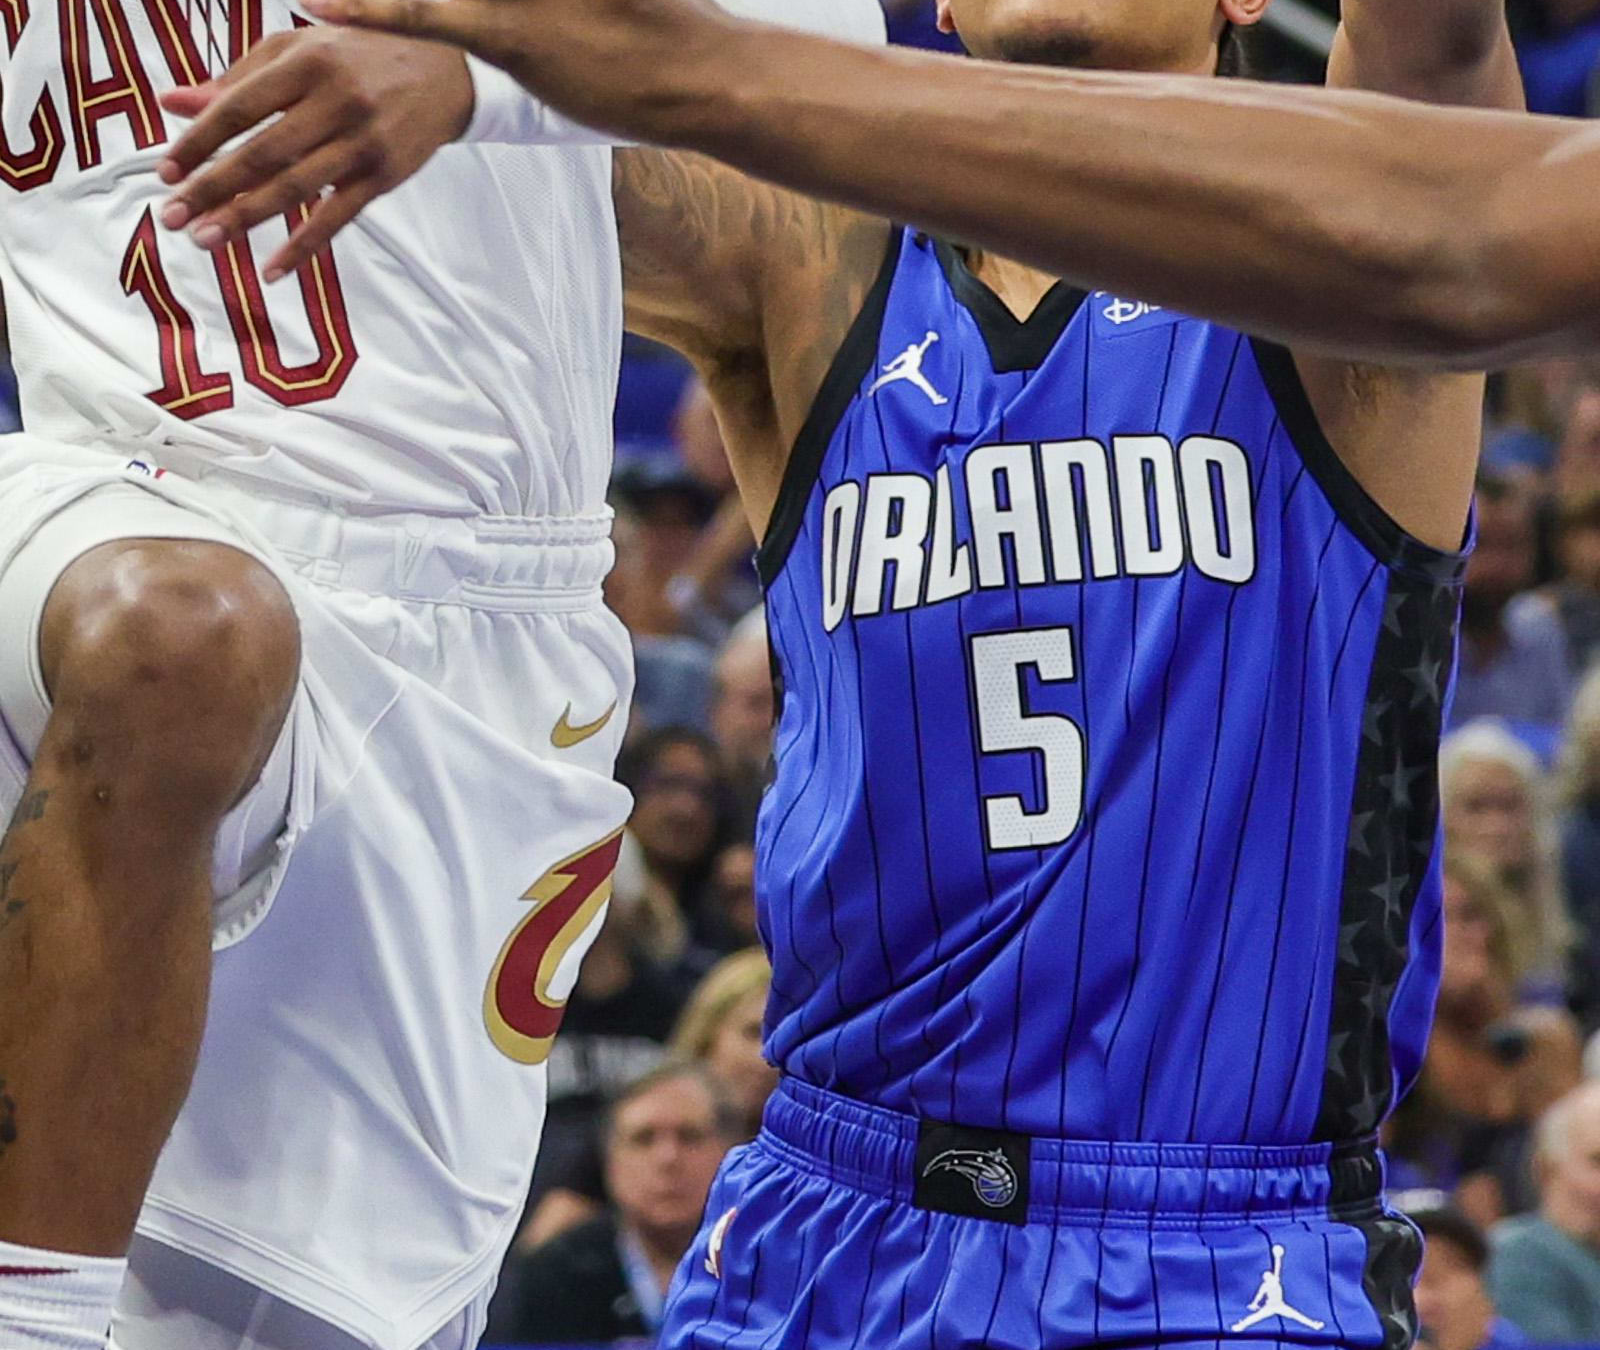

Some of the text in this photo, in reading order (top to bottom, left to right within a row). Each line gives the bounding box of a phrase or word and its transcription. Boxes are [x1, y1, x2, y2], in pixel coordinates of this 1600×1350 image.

[118, 193, 359, 421] 10
[820, 433, 1256, 633] ORLANDO
[968, 624, 1086, 852] 5
